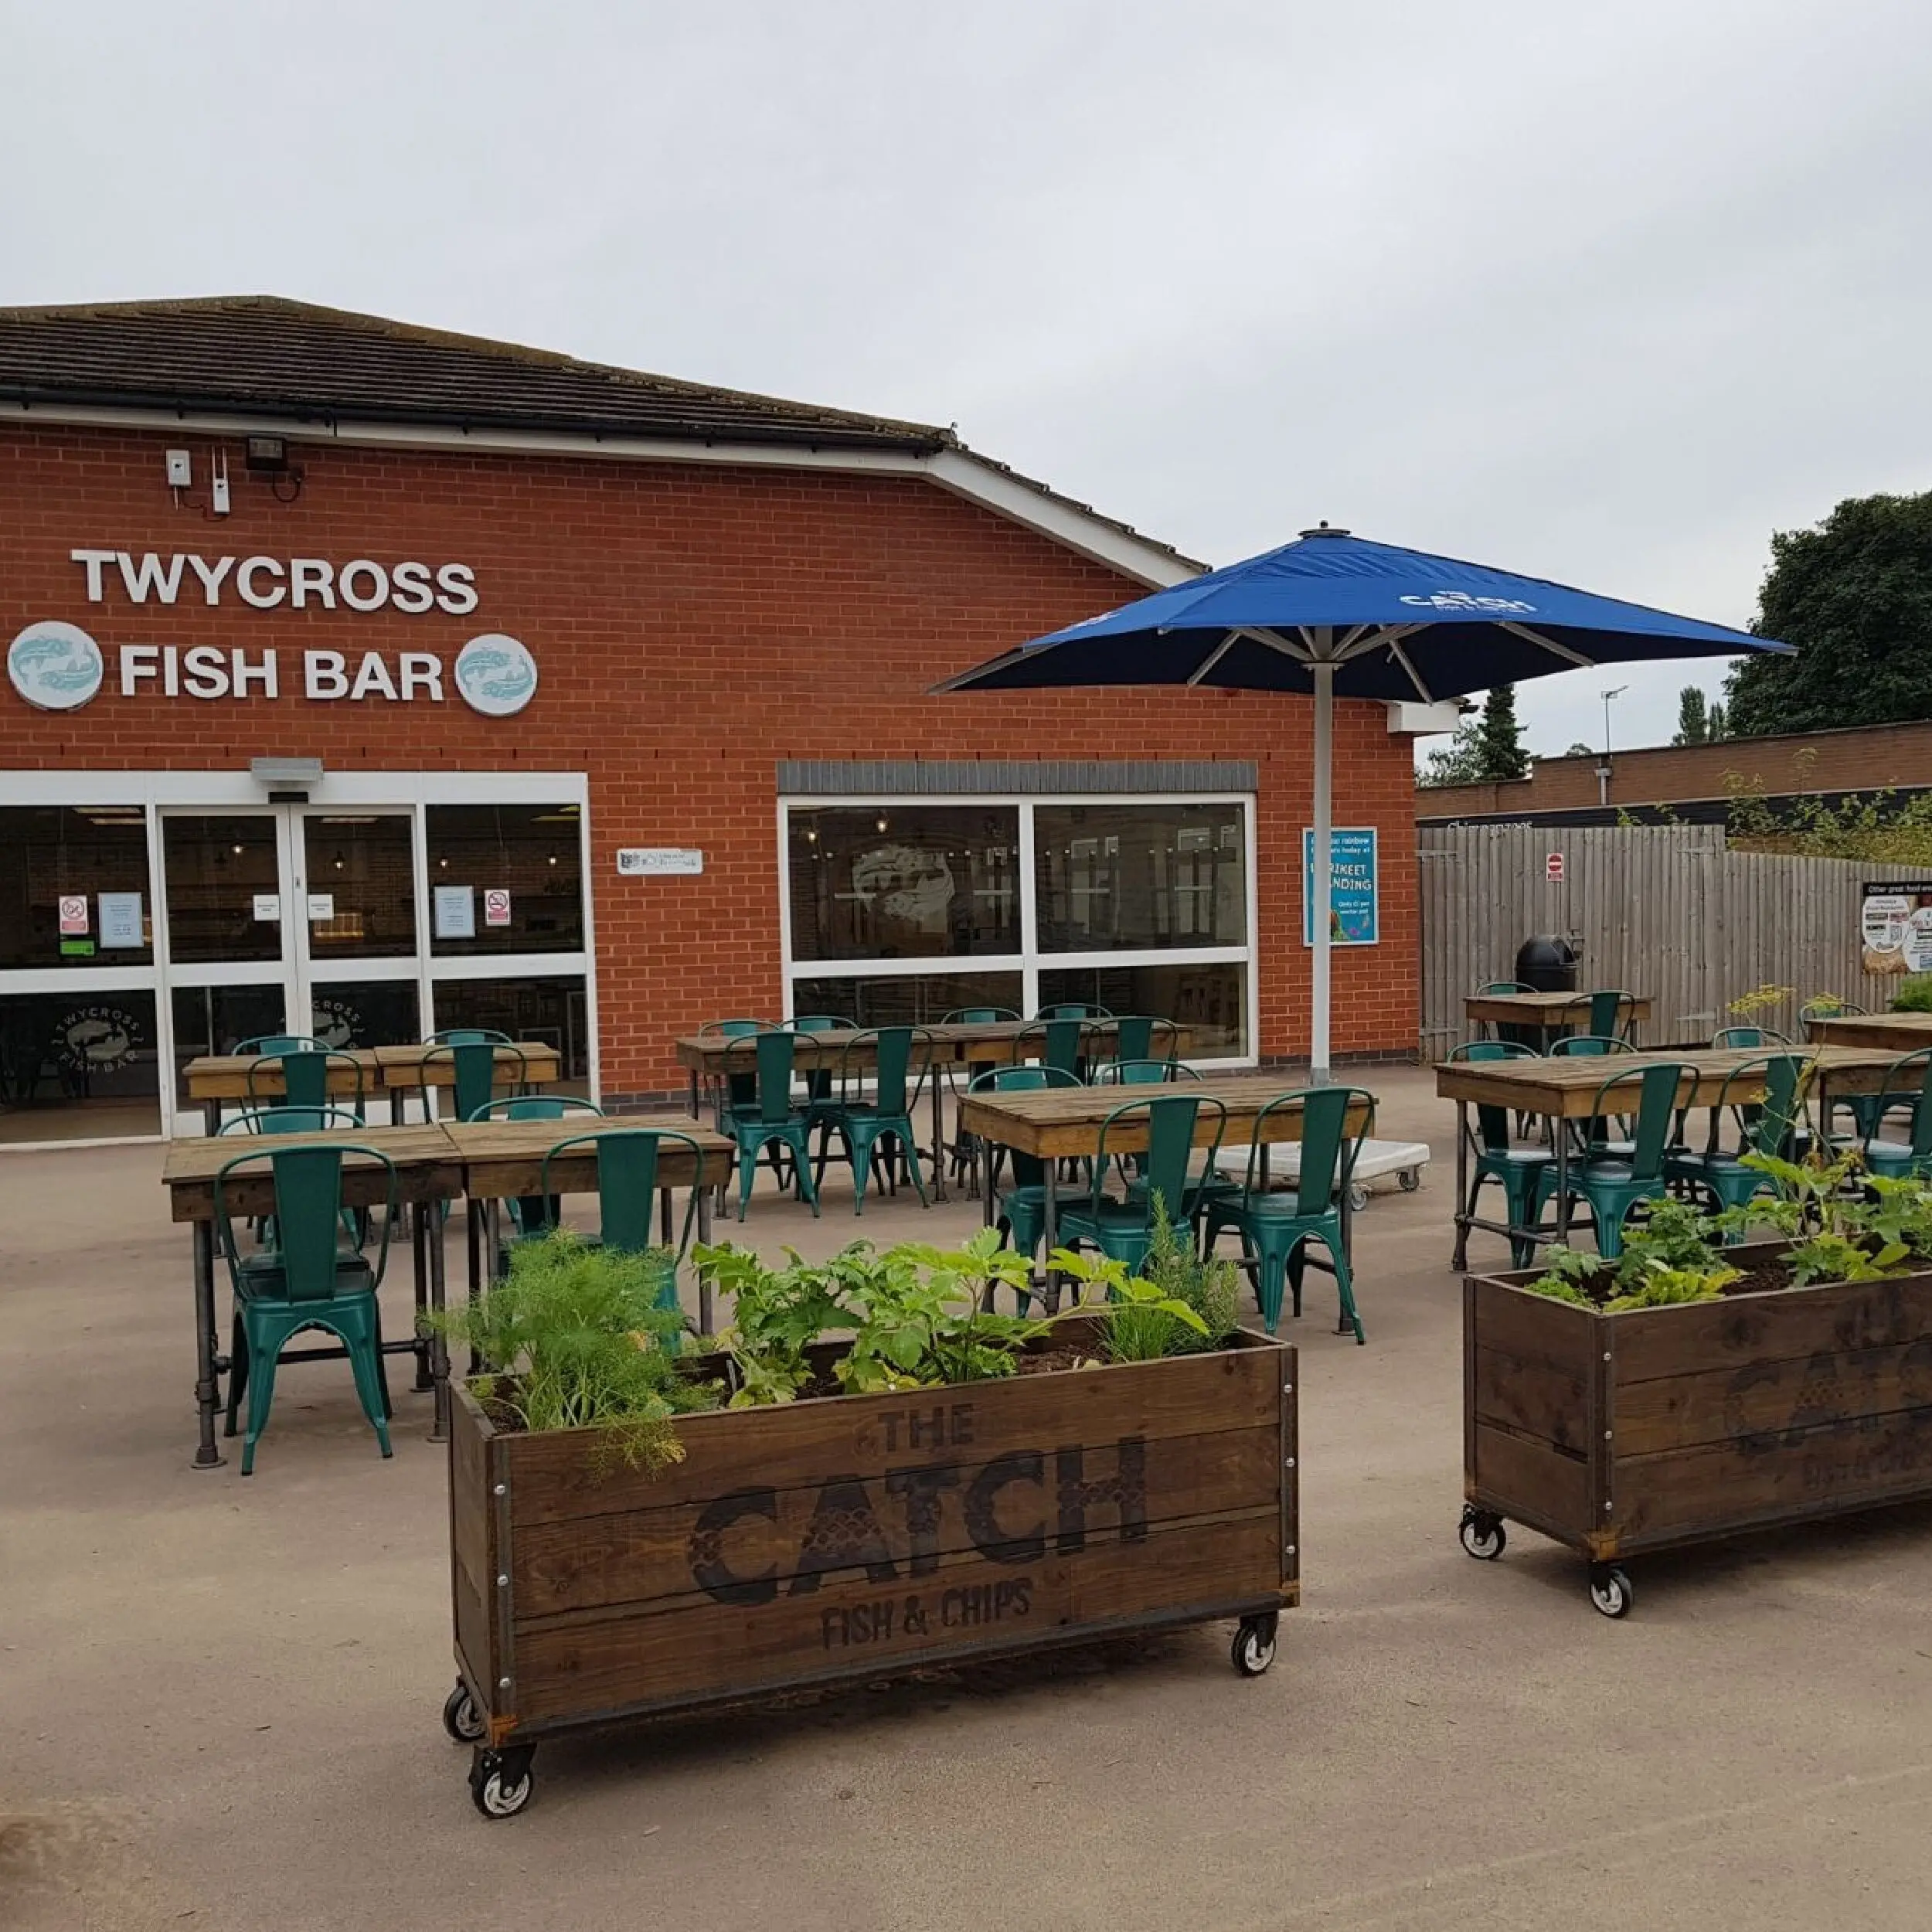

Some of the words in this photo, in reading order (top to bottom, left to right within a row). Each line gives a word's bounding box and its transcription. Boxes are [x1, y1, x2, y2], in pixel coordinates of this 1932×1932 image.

[71, 549, 479, 615] TWYCROSS
[119, 645, 279, 699] FISH
[304, 650, 444, 702] BAR
[878, 1403, 975, 1452] THE
[687, 1435, 1148, 1607] CATCH
[821, 1599, 893, 1651] FISH
[903, 1595, 927, 1638] &
[942, 1576, 1032, 1628] CHIPS
